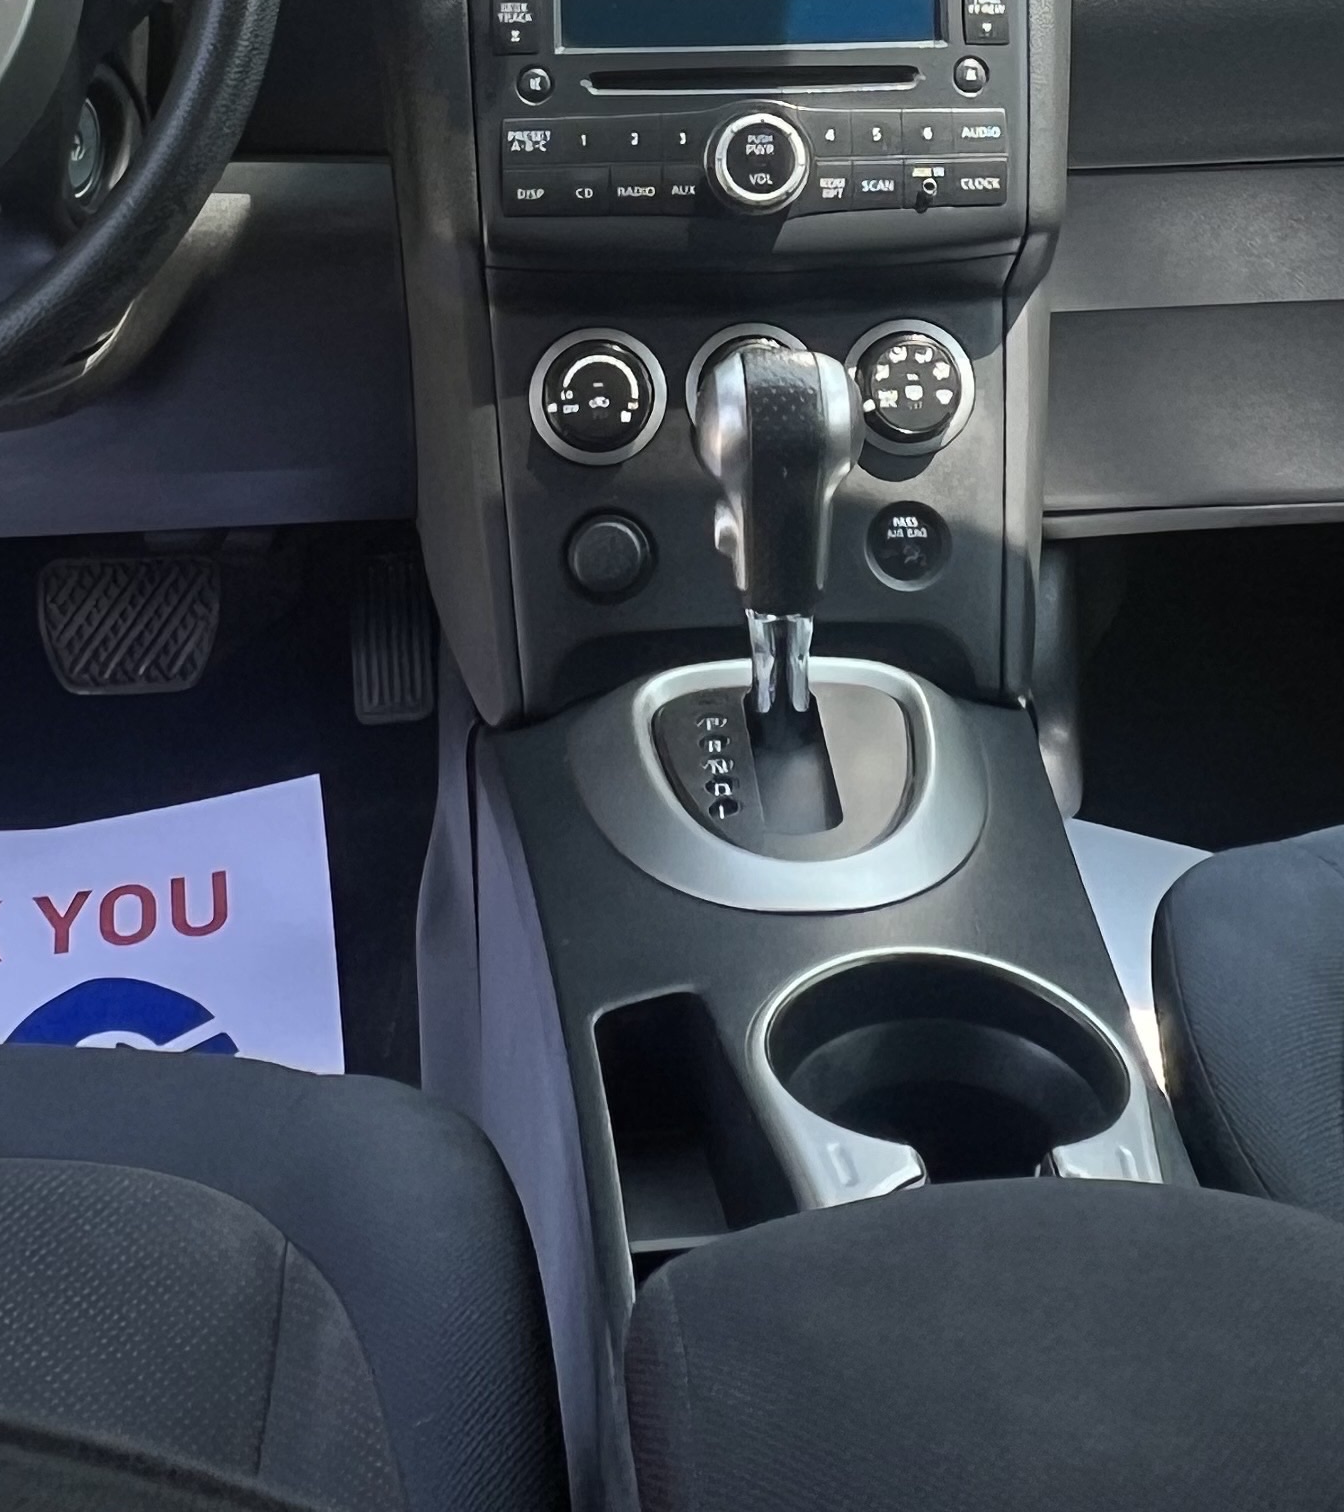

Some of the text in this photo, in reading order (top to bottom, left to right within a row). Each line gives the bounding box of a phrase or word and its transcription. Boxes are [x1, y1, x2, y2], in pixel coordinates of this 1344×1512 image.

[825, 128, 835, 141] 4
[872, 127, 882, 141] 5
[961, 126, 1001, 139] AUDIO
[749, 173, 774, 185] VOL
[861, 179, 894, 192] SCAN
[960, 176, 1001, 190] CLOCK
[575, 188, 594, 199] CD
[617, 185, 656, 197] RADIO
[670, 185, 696, 196] AUX
[32, 870, 230, 954] YOU
